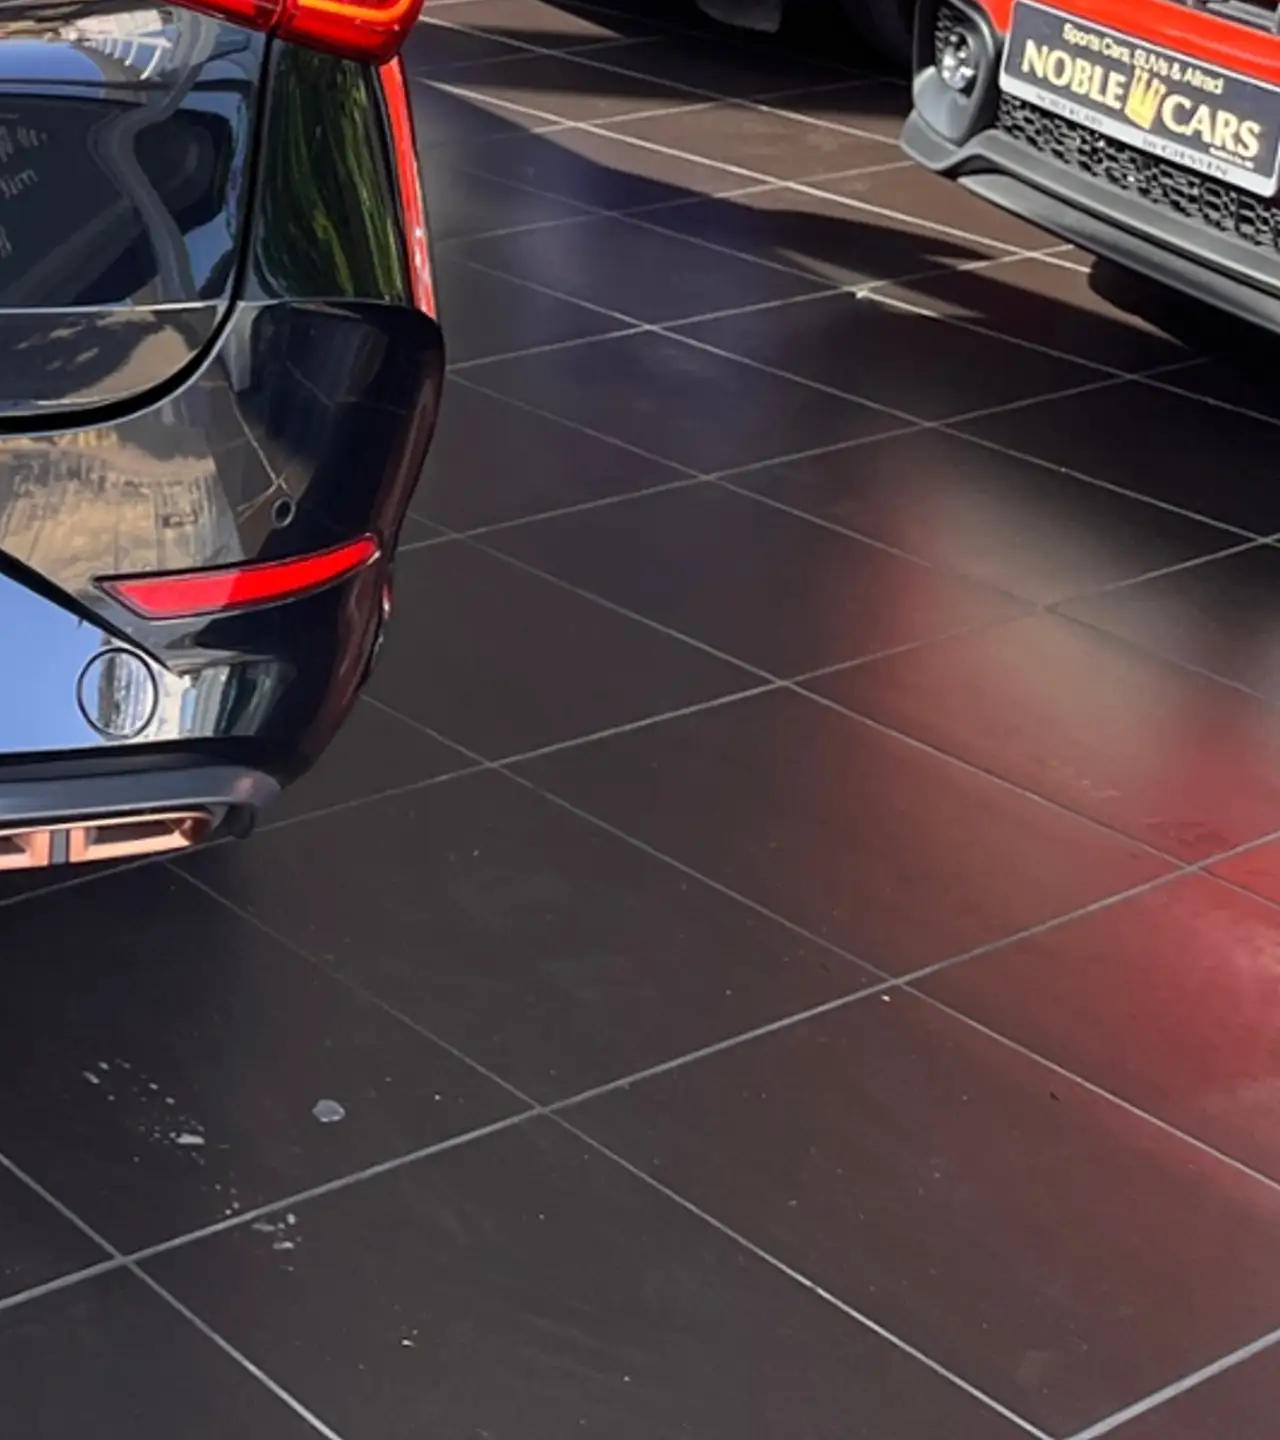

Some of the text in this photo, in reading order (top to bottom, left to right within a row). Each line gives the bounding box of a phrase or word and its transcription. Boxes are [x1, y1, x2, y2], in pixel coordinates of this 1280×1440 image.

[1021, 38, 1262, 158] NOBLE CARS
[1062, 23, 1100, 53] Sports
[1169, 62, 1182, 80] &
[1183, 67, 1224, 95] Allrad
